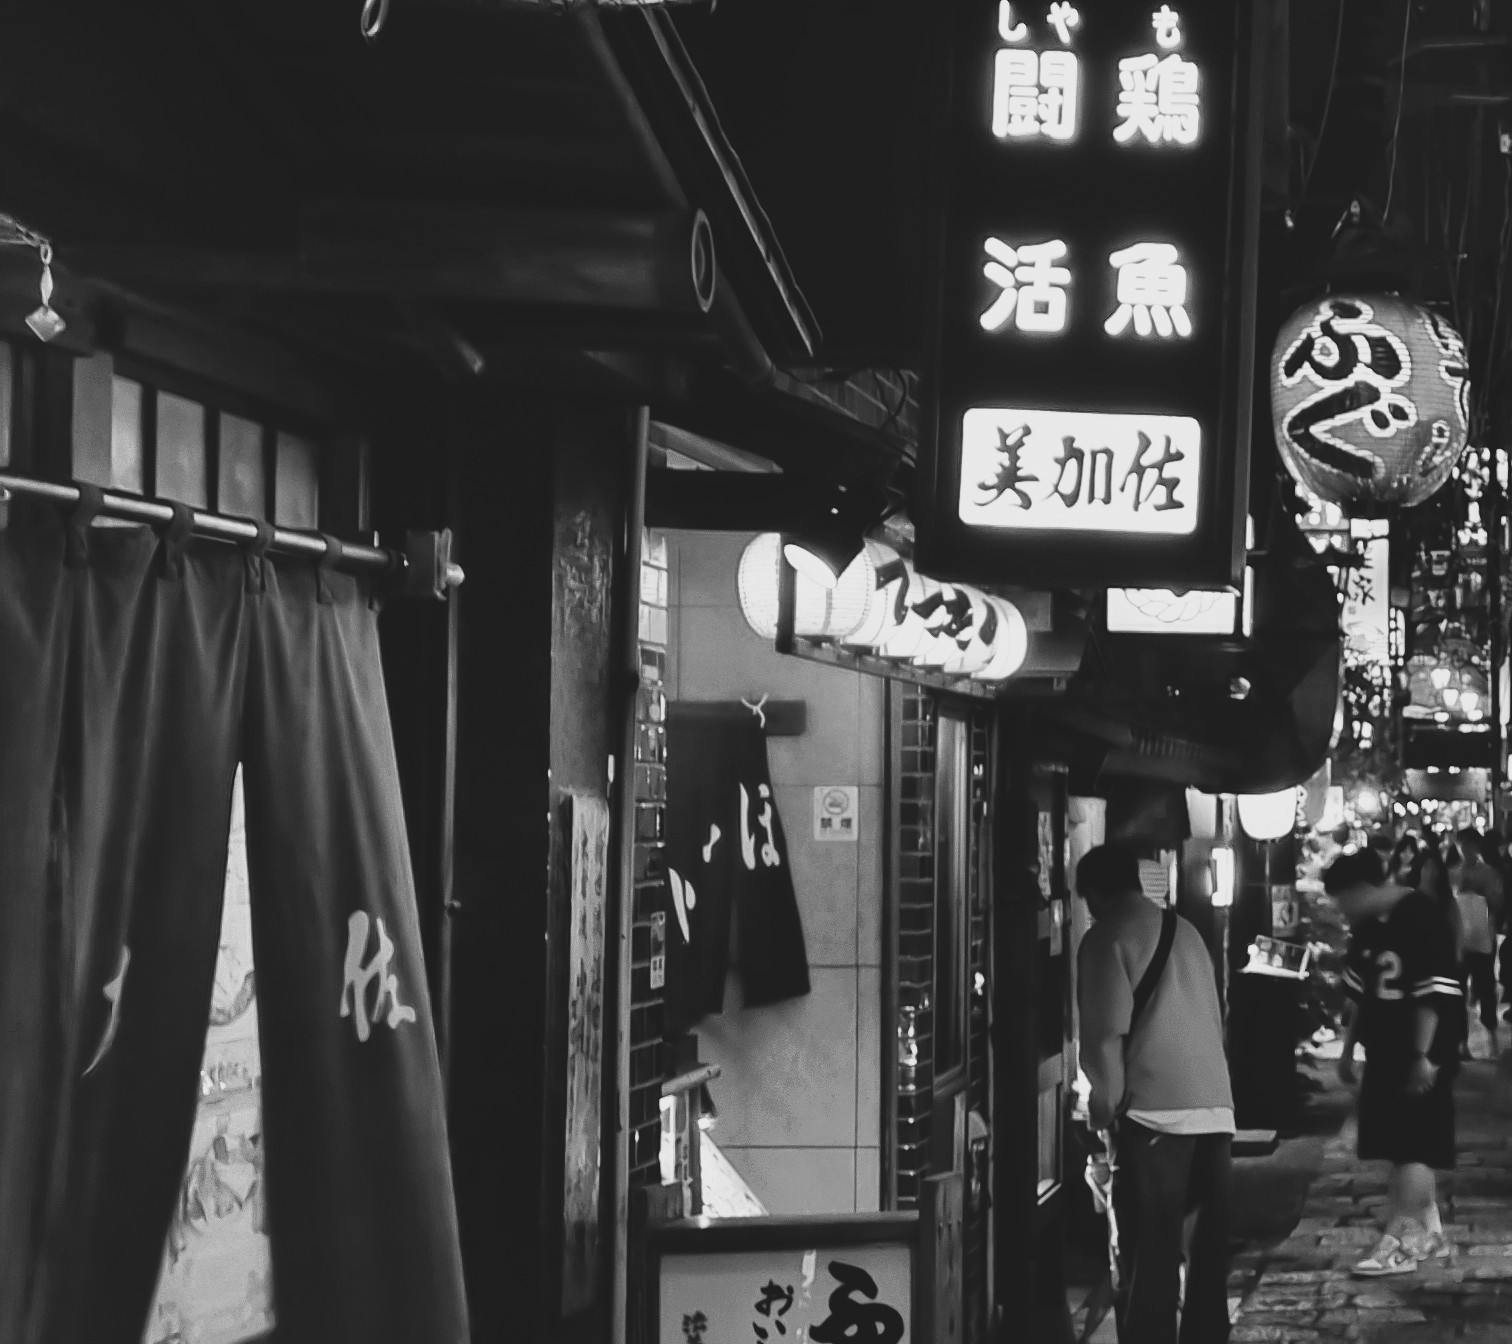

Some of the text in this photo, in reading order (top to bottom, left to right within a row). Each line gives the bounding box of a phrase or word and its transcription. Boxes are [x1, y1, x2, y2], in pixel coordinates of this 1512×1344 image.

[992, 47, 1200, 144] 闘鶏
[980, 237, 1192, 338] 活魚
[1279, 299, 1418, 481] ふぐ
[975, 424, 1185, 513] 美加佐
